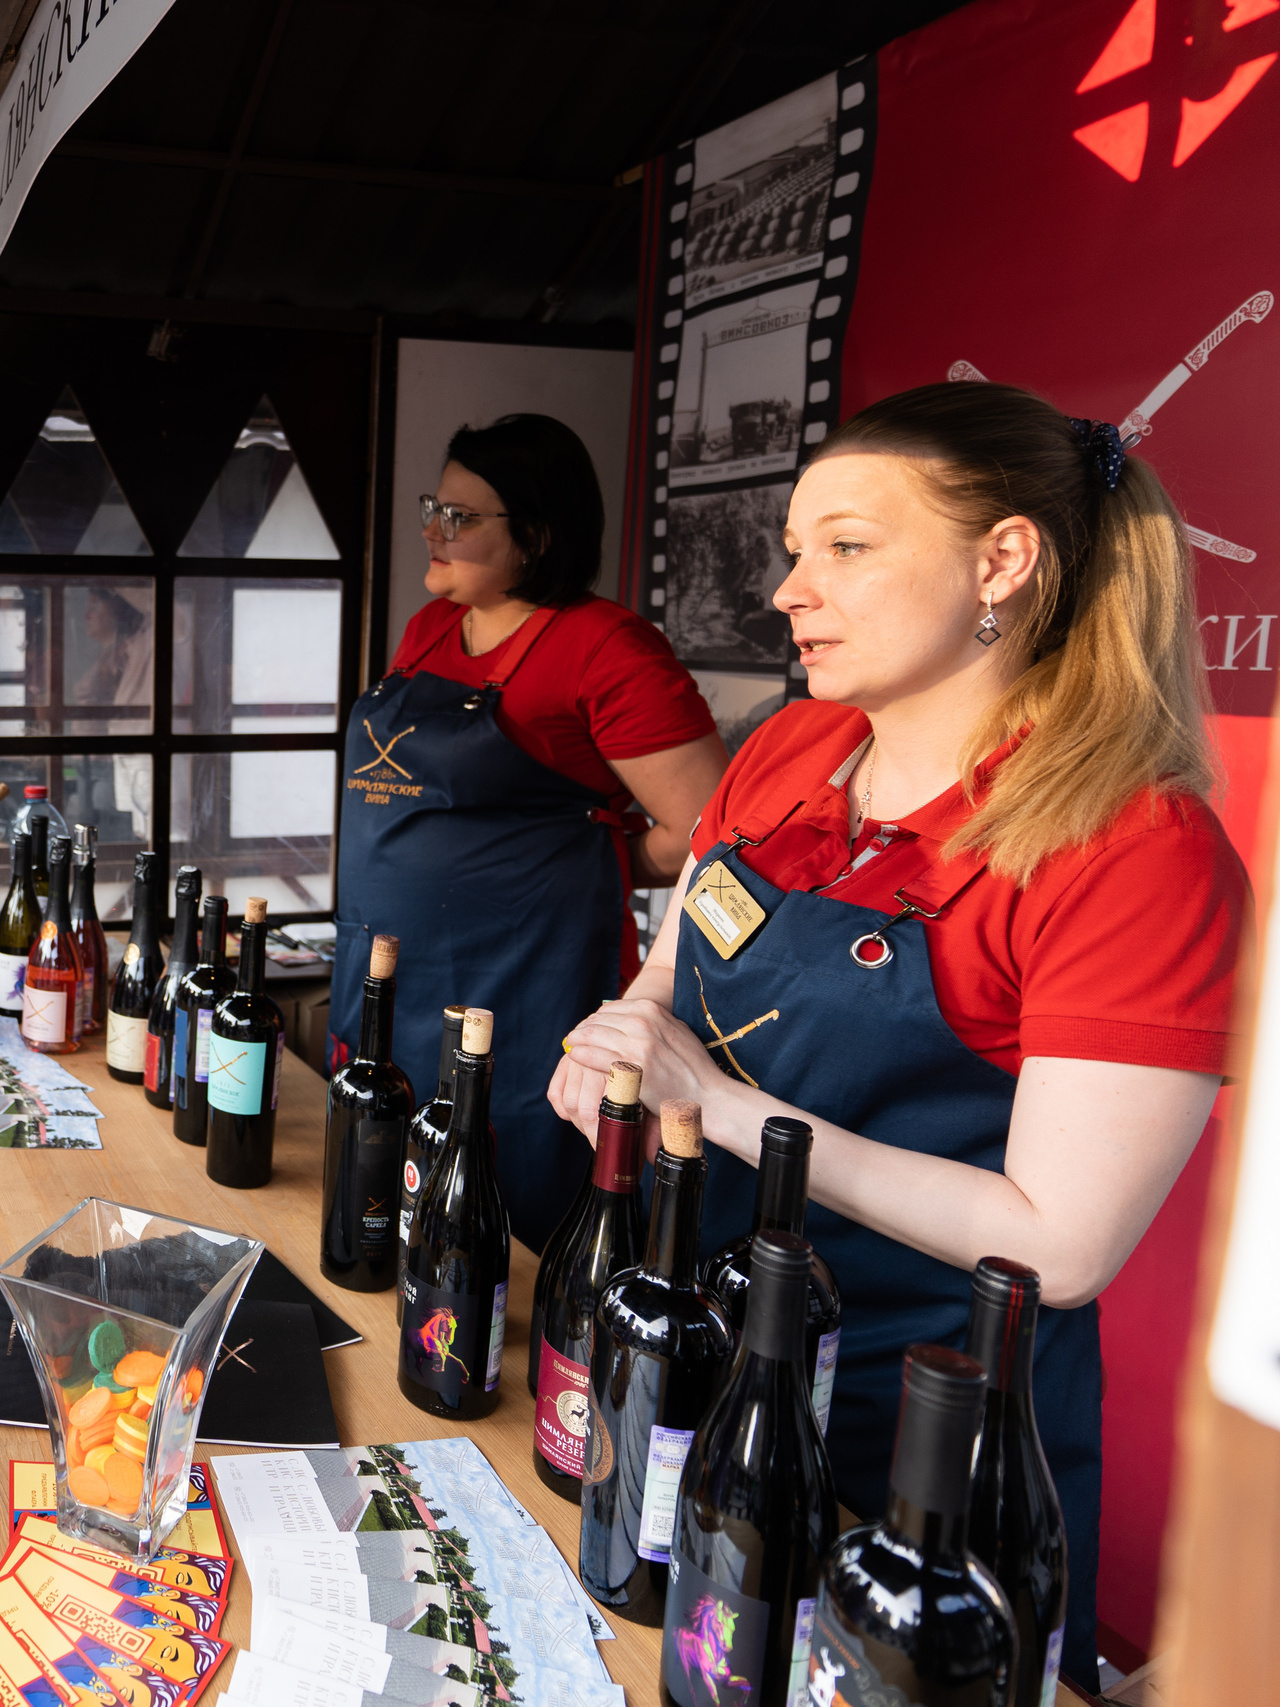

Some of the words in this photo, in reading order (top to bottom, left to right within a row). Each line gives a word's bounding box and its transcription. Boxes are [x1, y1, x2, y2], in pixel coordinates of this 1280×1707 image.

[347, 778, 423, 798] ЦИМЛЯНСКИЕ
[365, 793, 390, 805] ВИНА
[541, 1417, 586, 1450] ЦИМЛЯН
